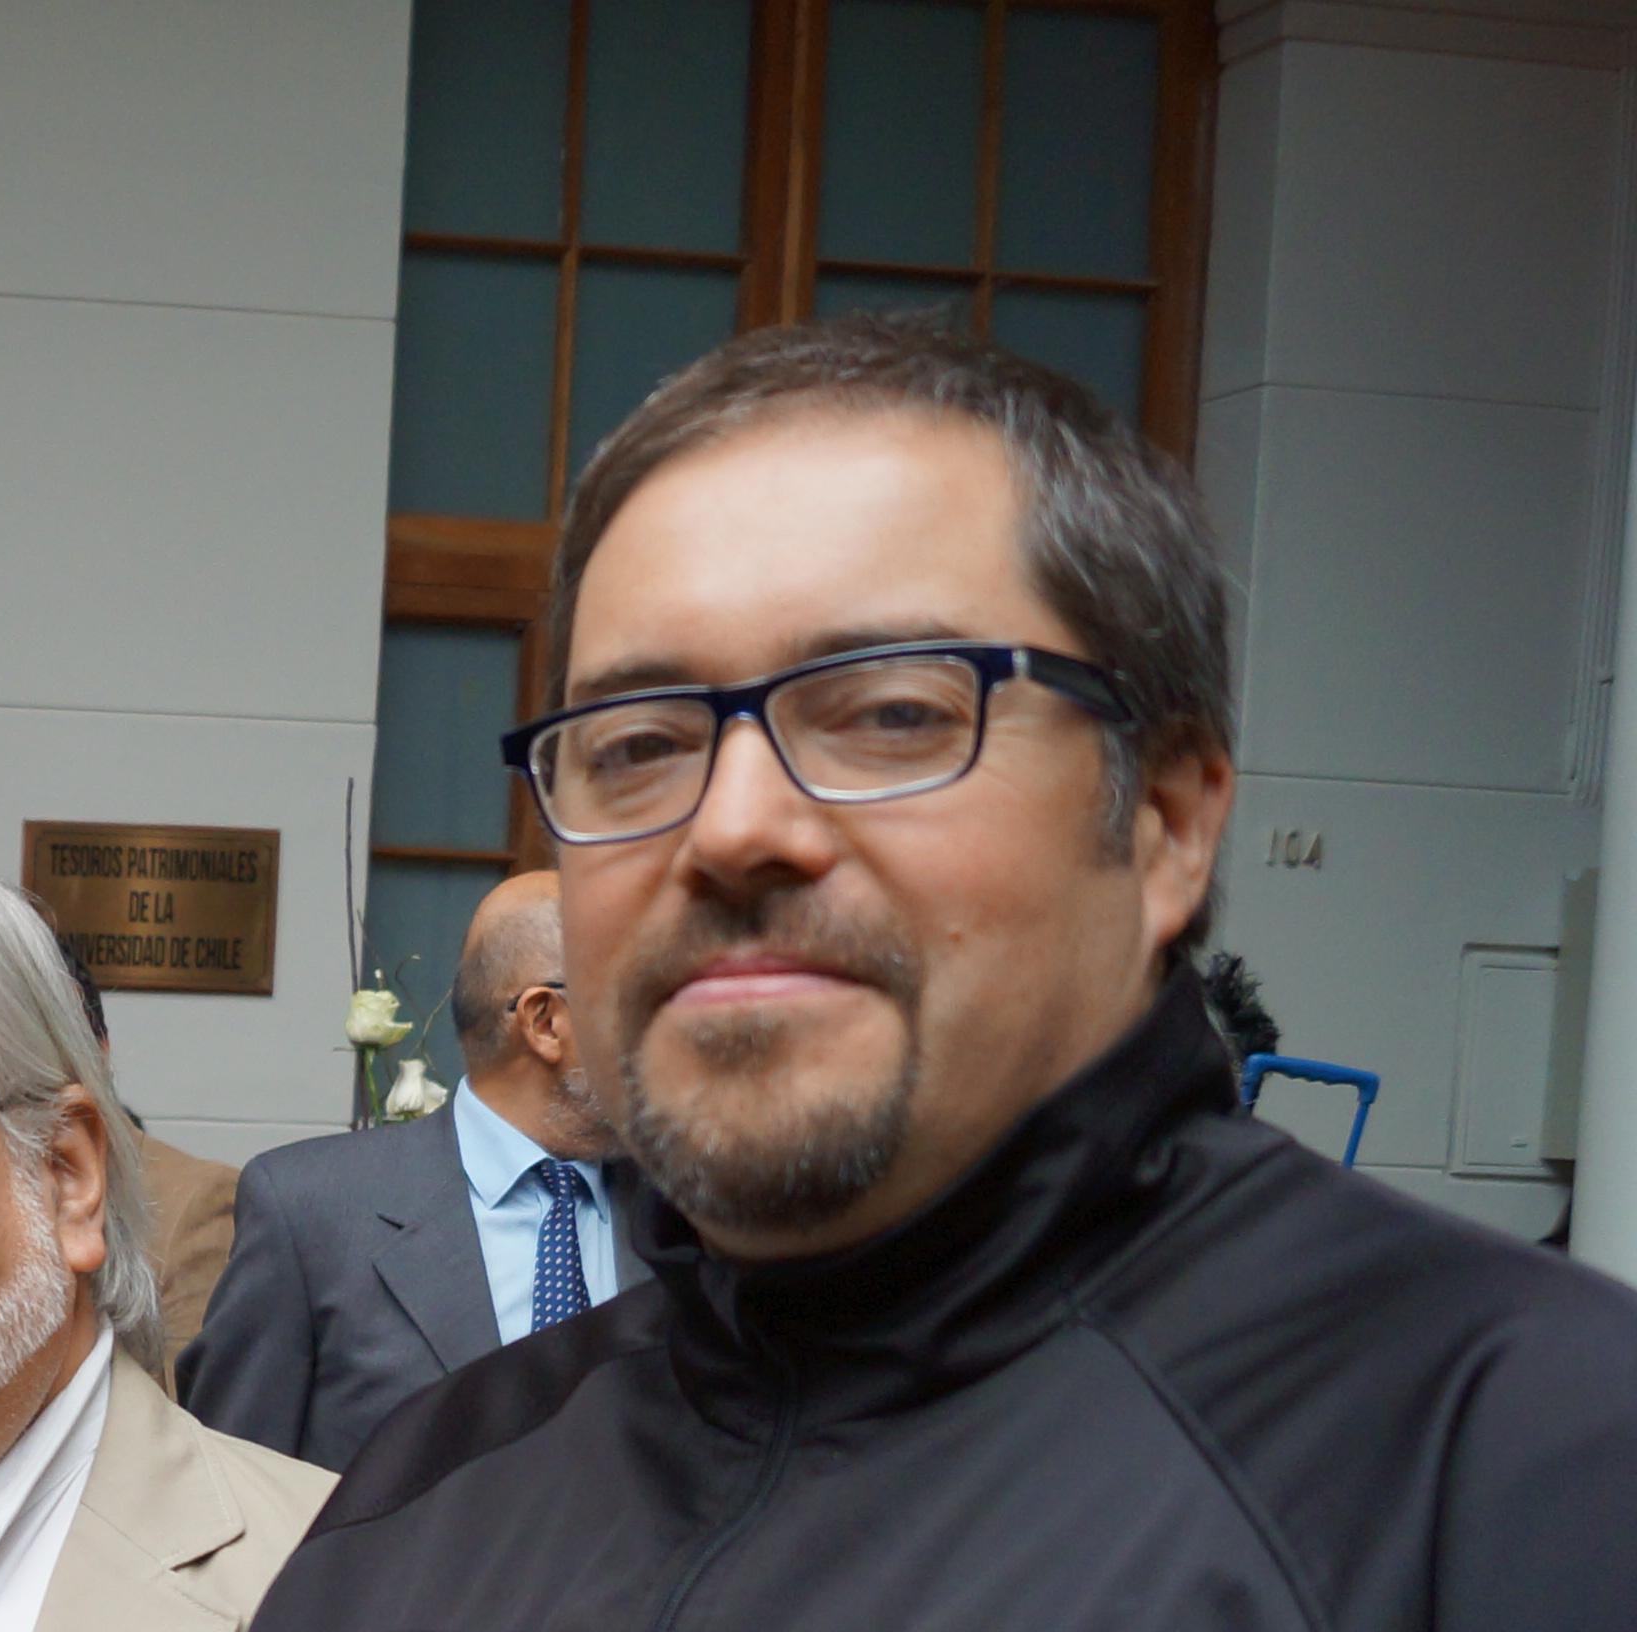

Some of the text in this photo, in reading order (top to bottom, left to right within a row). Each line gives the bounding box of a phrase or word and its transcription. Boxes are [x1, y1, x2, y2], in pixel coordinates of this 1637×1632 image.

[50, 843, 258, 883] TESOROS PATRIMONIALES
[129, 890, 174, 924] DE LA
[59, 933, 242, 970] NIVERSIDAD DE CHILE
